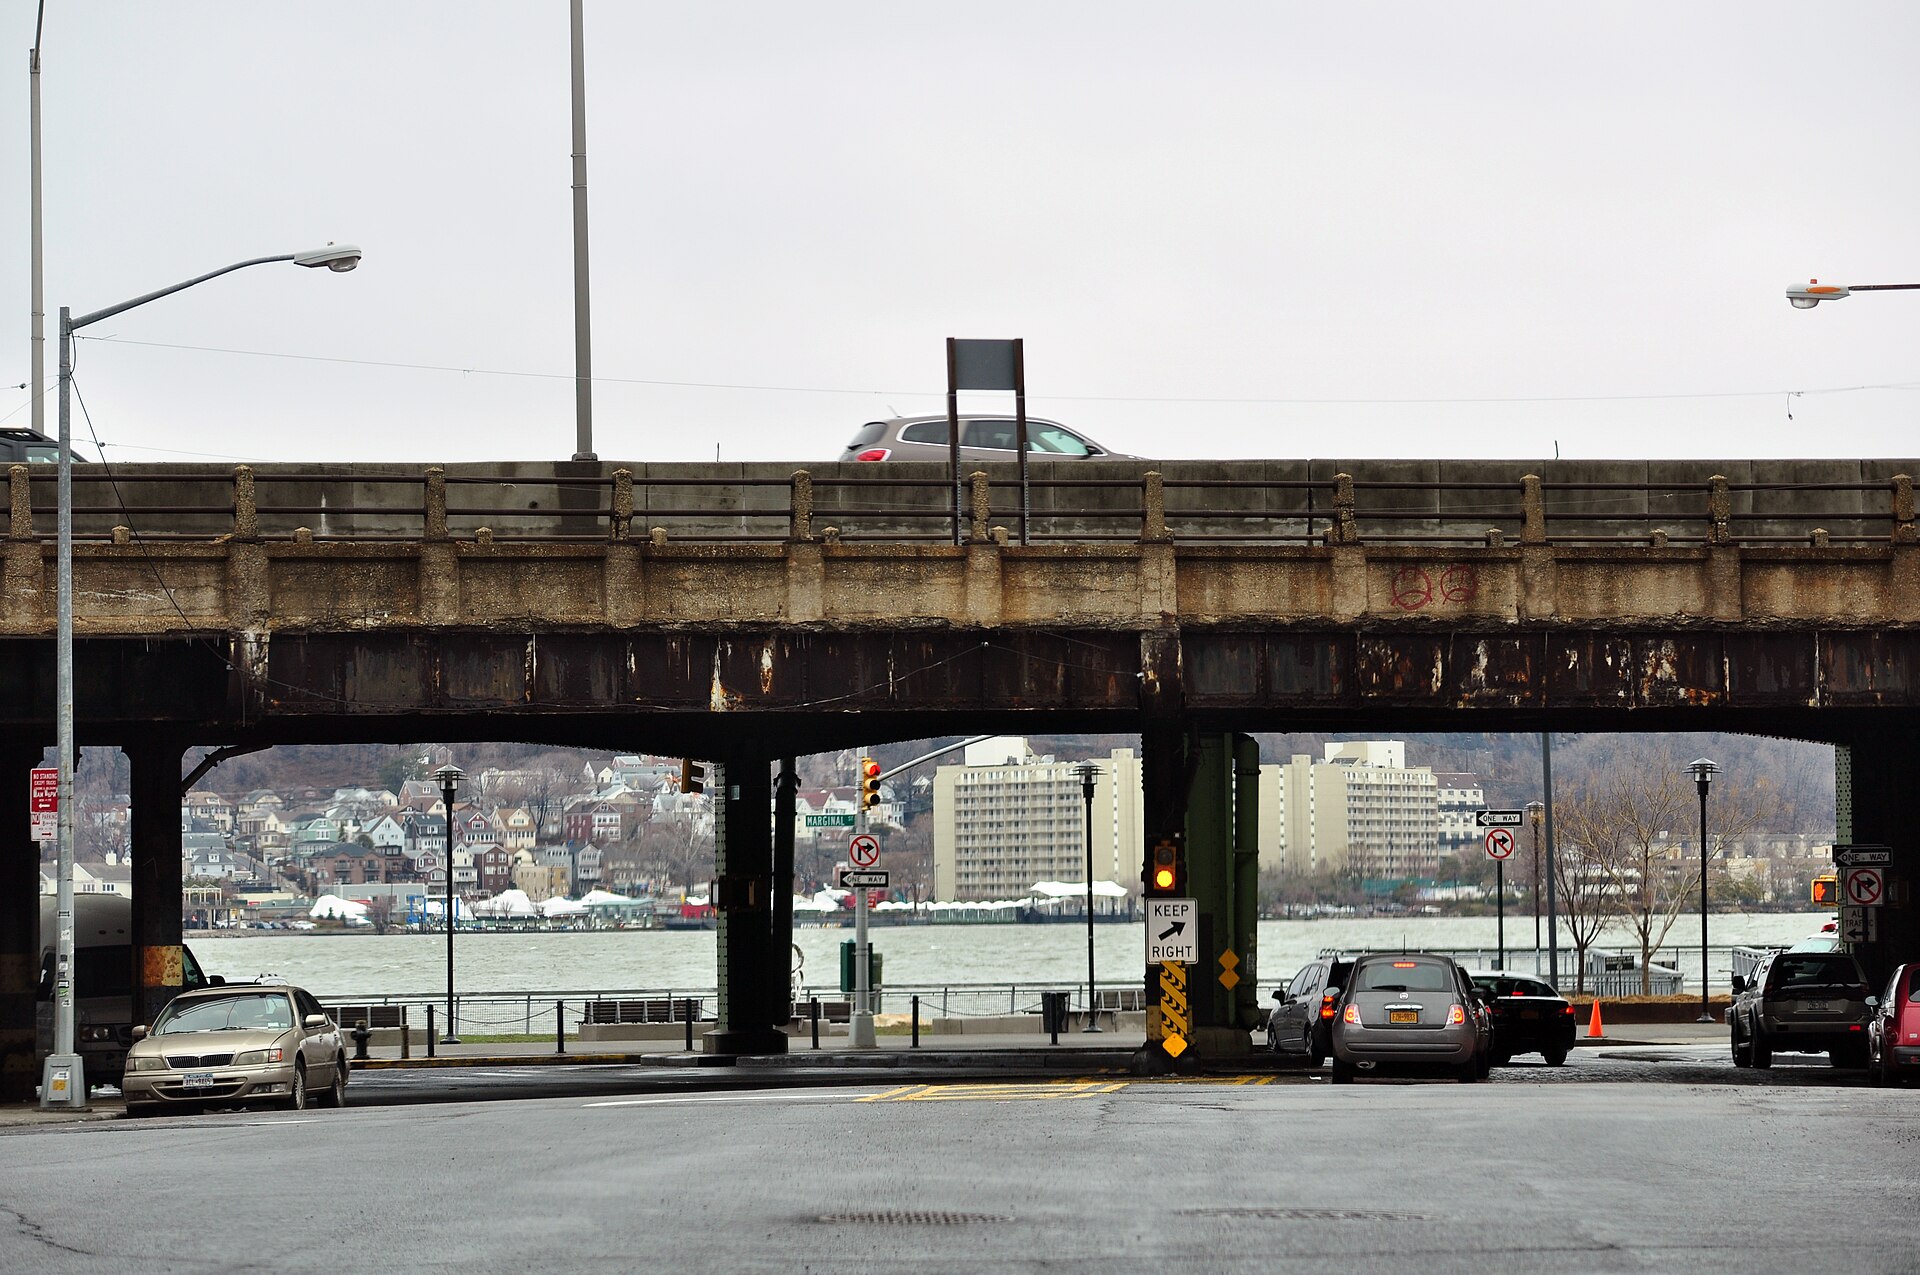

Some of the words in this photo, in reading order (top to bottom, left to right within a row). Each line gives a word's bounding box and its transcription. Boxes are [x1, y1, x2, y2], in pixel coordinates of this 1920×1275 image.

[806, 816, 845, 826] MARGINAL
[1841, 853, 1860, 862] ONE
[1869, 853, 1887, 861] WAY
[1154, 904, 1189, 917] KEEP
[1846, 919, 1874, 927] TRAFC
[1152, 945, 1193, 958] RIGHT
